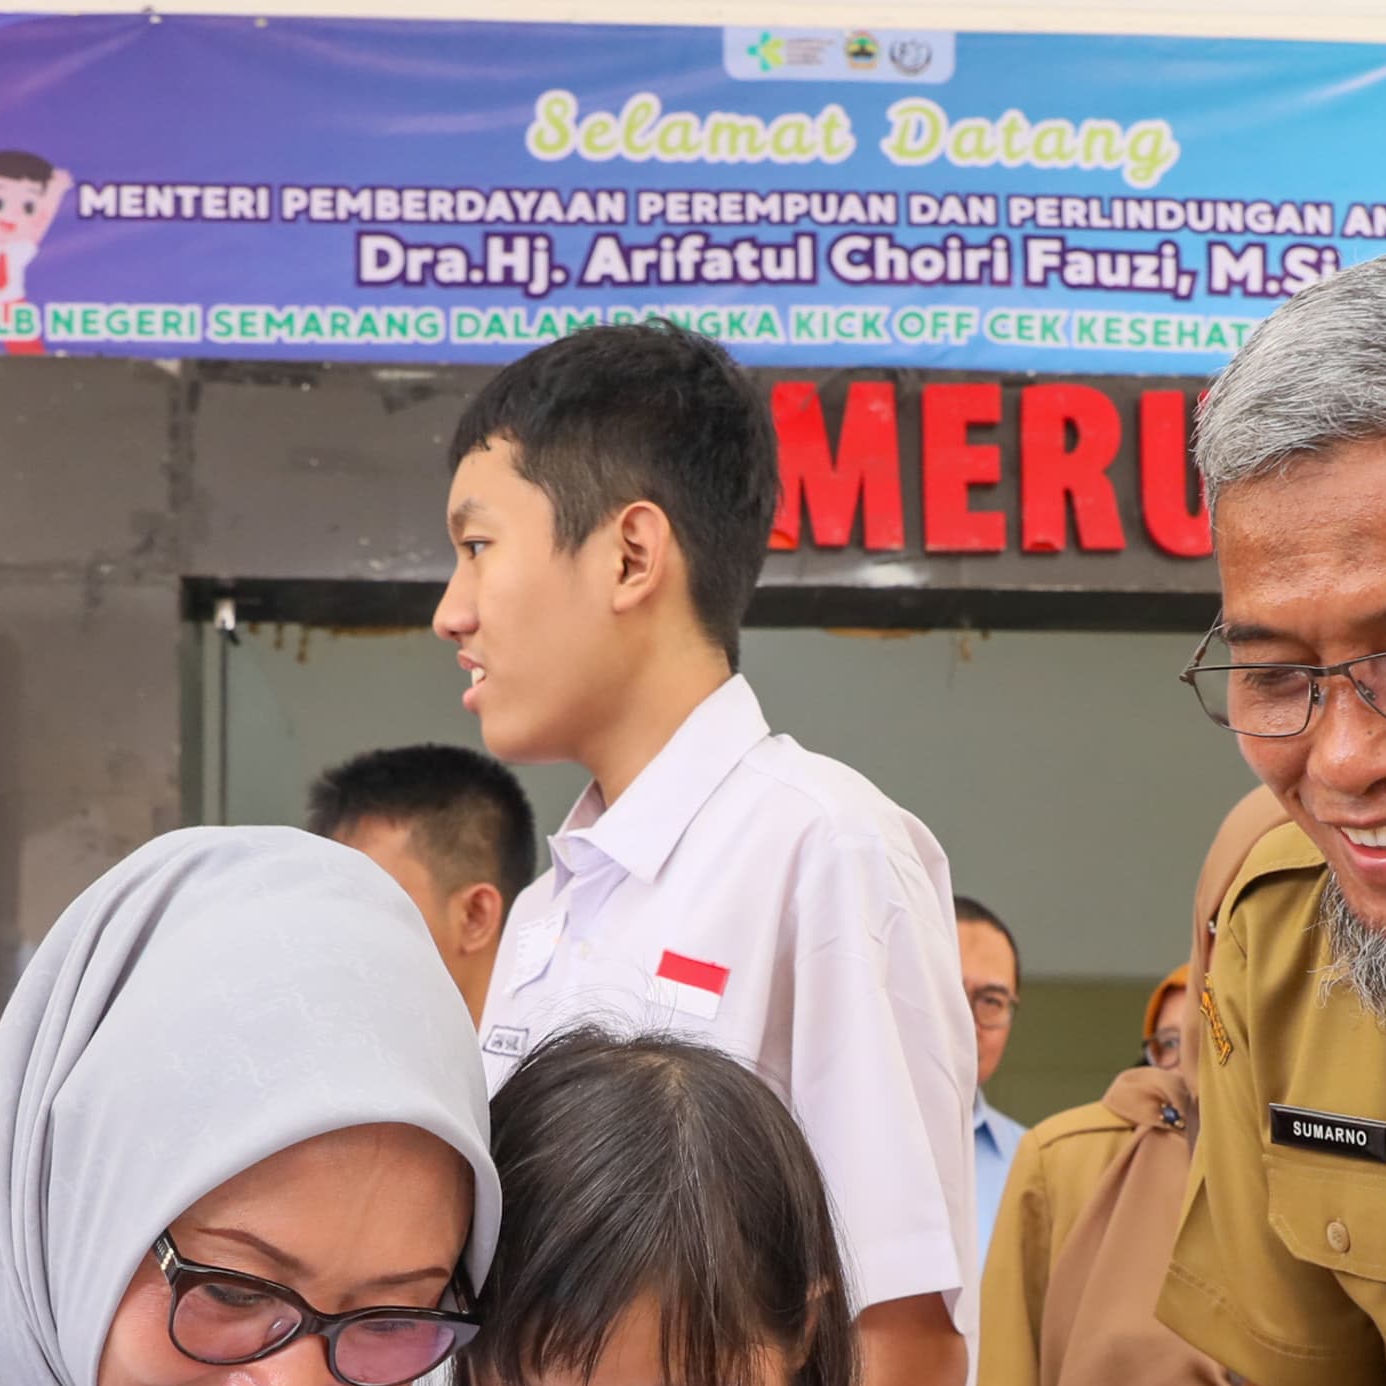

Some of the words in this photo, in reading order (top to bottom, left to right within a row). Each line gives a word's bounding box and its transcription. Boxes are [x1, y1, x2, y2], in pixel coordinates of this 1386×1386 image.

[531, 94, 850, 159] Selamat
[887, 103, 1175, 183] Datang
[79, 185, 270, 220] MENTERI
[282, 187, 625, 223] PEMBERDAYAAN
[640, 193, 896, 224] PEREMPUAN
[912, 197, 995, 226] DAN
[1018, 199, 1332, 235] PERLINDUNGAN
[359, 236, 565, 295] Dra.Hj.
[585, 236, 813, 284] Arifatul
[830, 238, 1009, 286] Choiri
[1028, 240, 1194, 298] Fauzi,
[49, 308, 198, 338] NEGERI
[213, 310, 441, 340] SEMARANG
[456, 312, 596, 338] DALAM
[795, 312, 888, 341] KICK
[897, 314, 973, 343] OFF
[989, 315, 1062, 344] CEK
[1077, 316, 1250, 348] KESEHAT
[1293, 1120, 1367, 1146] SUMARNO
